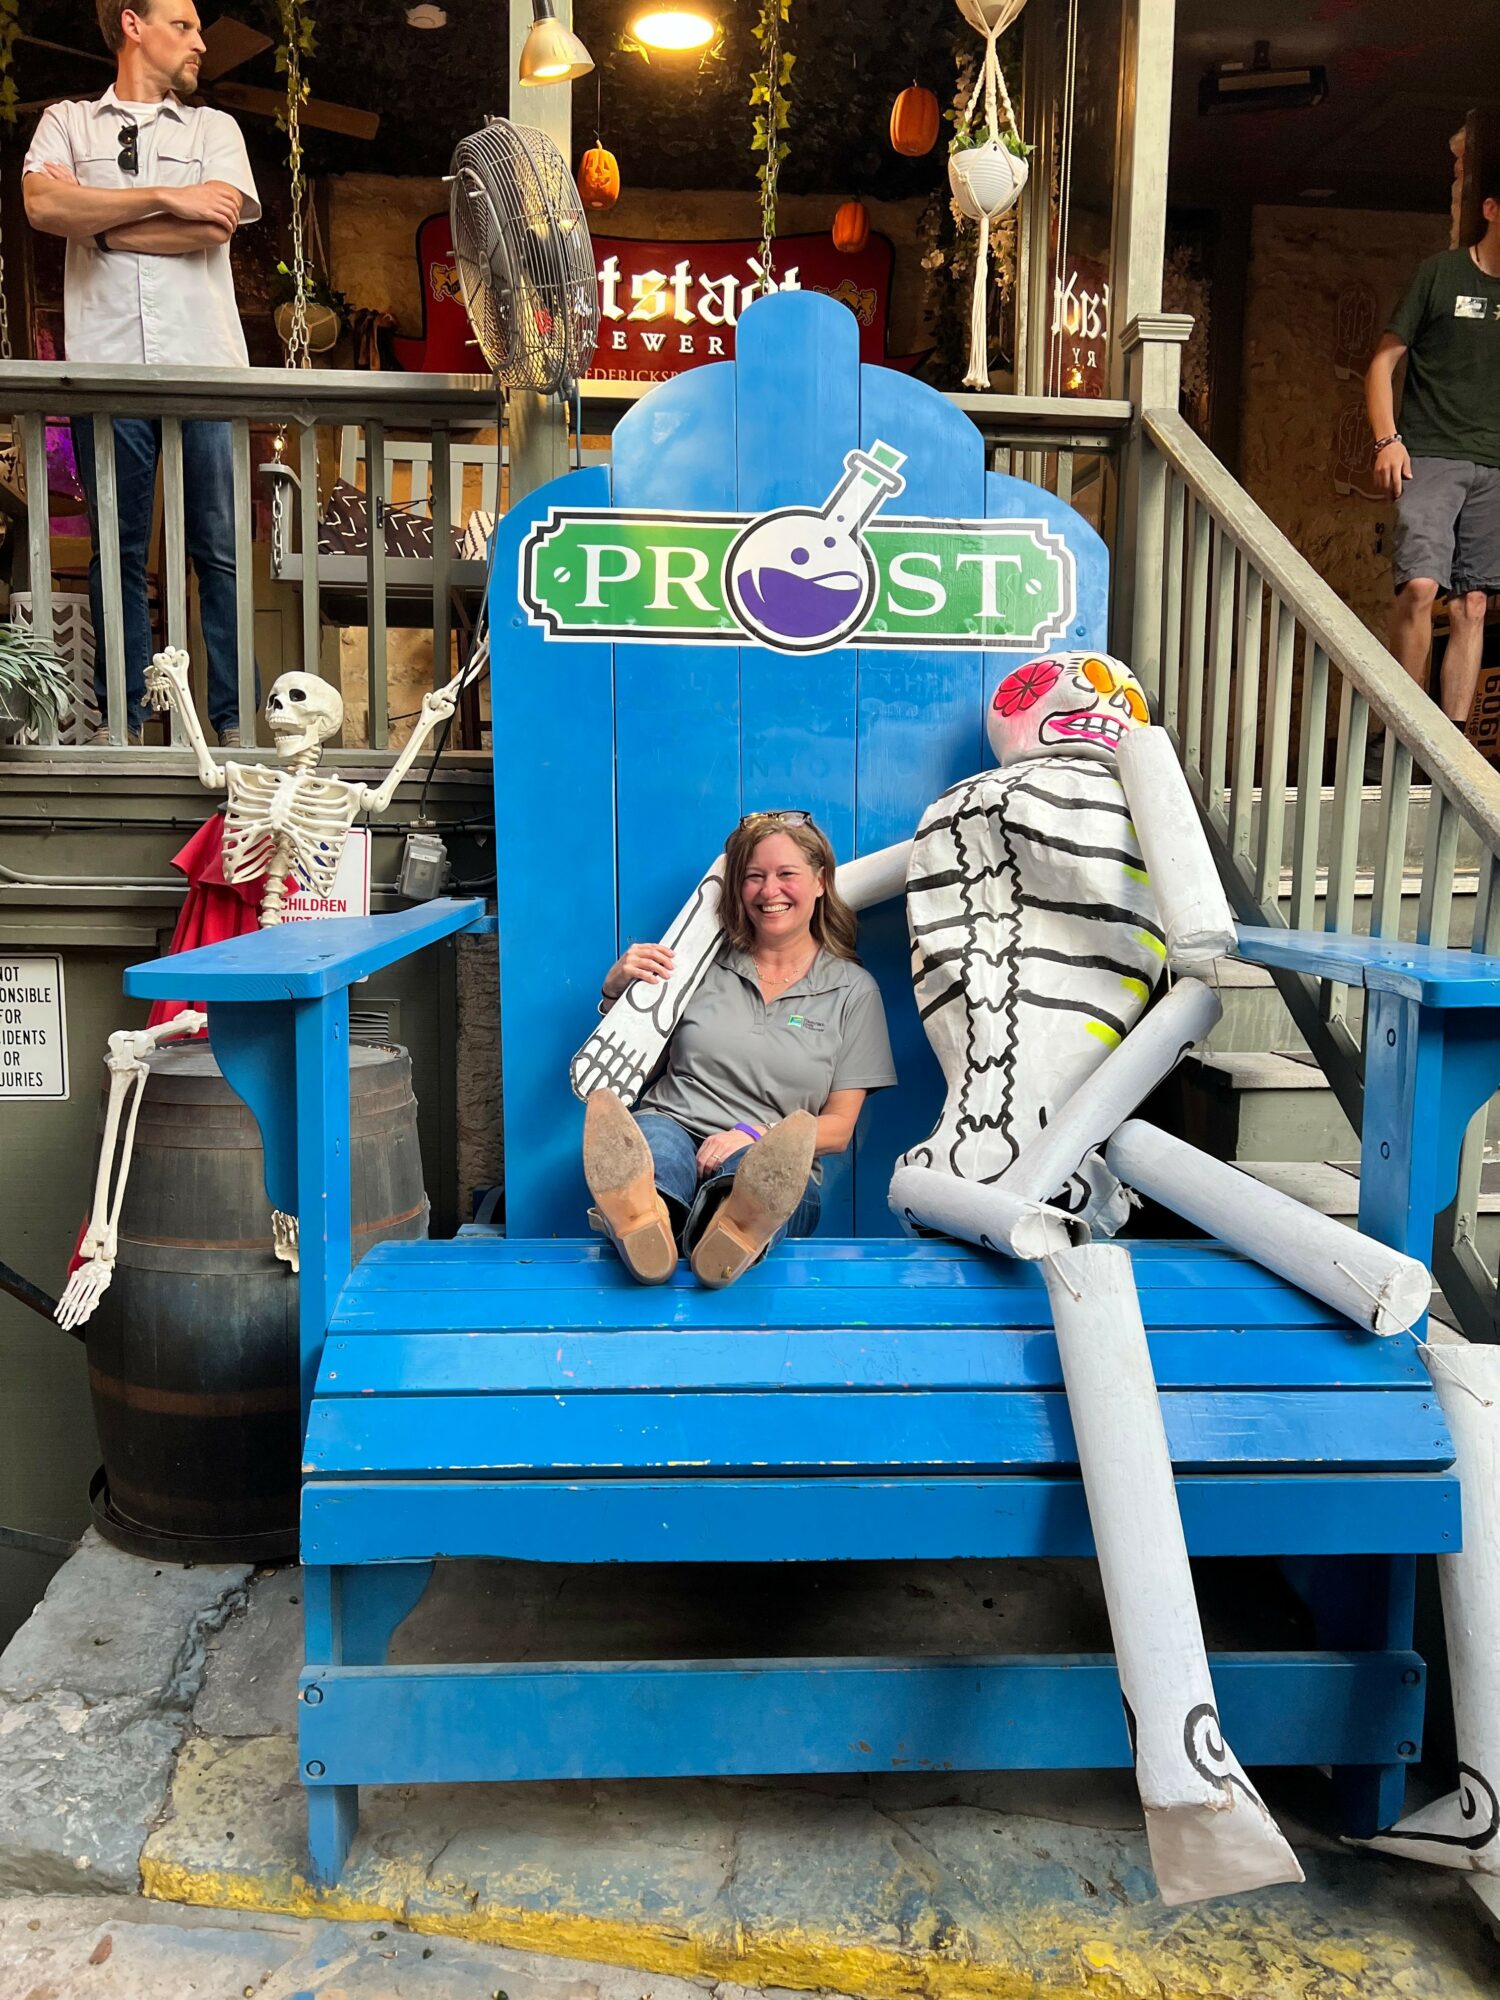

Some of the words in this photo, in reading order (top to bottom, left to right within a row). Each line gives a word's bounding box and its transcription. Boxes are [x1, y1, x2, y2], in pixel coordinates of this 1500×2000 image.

[1478, 674, 1500, 747] 1909
[280, 897, 347, 912] CHILDREN
[0, 1030, 46, 1045] IDENTS
[4, 1051, 20, 1066] OR
